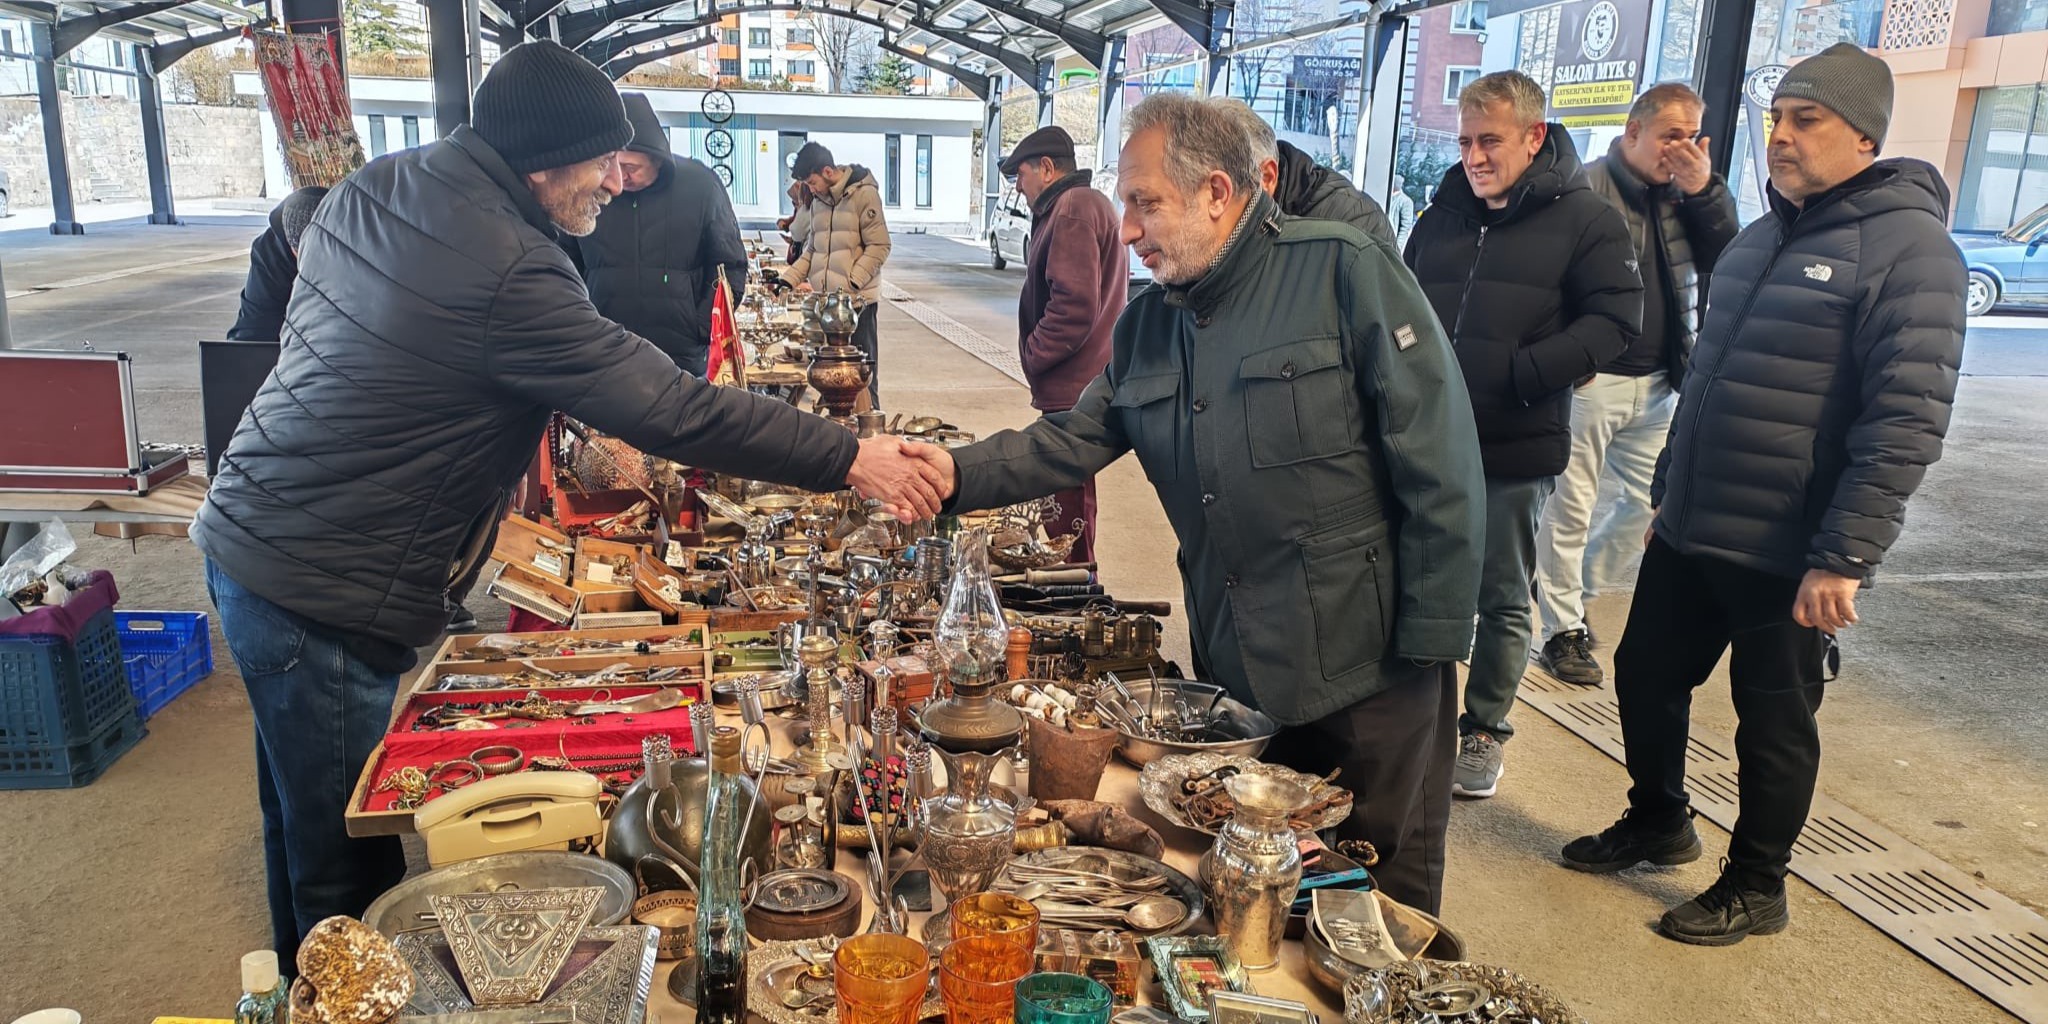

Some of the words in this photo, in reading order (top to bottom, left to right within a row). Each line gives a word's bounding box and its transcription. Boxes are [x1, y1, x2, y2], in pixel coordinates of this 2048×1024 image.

[1555, 62, 1595, 83] SALON
[1595, 60, 1626, 80] MYK
[1627, 60, 1636, 78] 9
[1617, 83, 1632, 92] TEK
[1558, 97, 1591, 106] KAMPANYA
